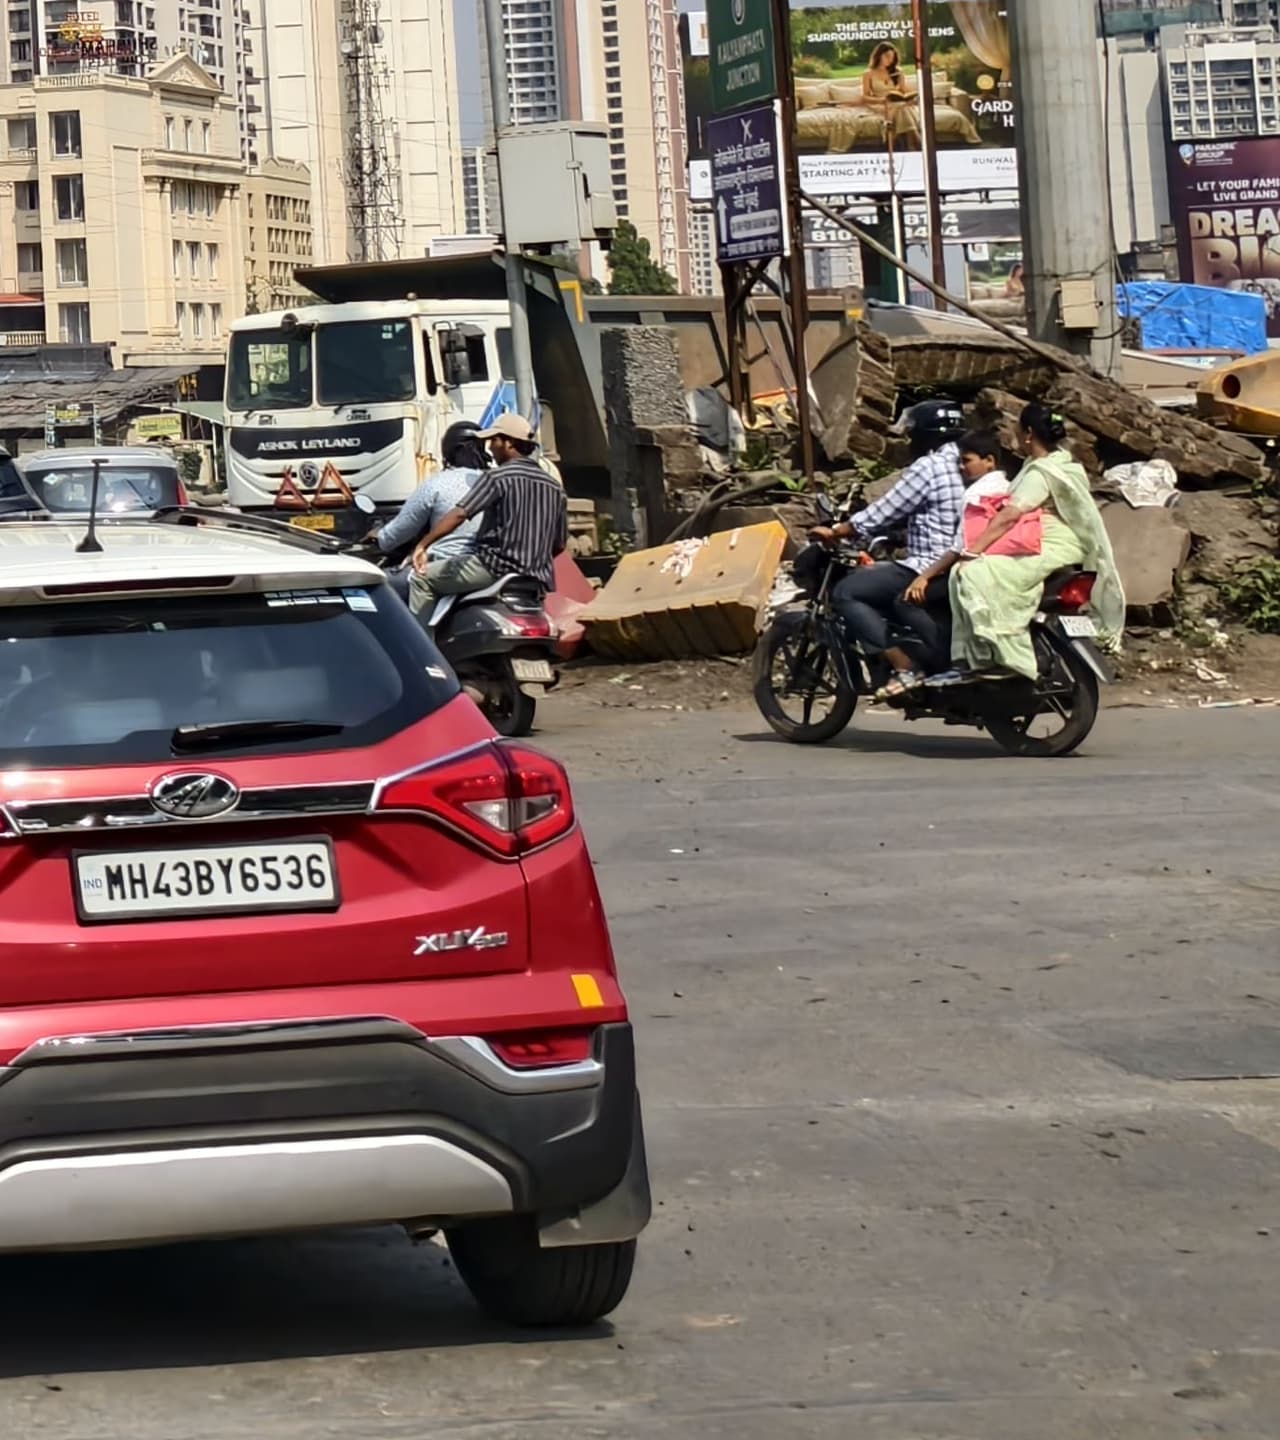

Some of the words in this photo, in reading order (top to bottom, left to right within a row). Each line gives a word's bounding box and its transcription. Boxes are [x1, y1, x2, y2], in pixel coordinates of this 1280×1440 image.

[835, 22, 859, 33] THE
[860, 20, 900, 31] READY
[807, 30, 889, 43] SURROUNDED
[890, 29, 906, 39] BY
[801, 168, 855, 179] STARTING
[1197, 181, 1216, 191] LET
[1218, 179, 1250, 191] YOUR
[1213, 192, 1238, 203] LIVE
[1239, 190, 1279, 200] GRAND
[257, 440, 298, 452] ASHOK
[301, 437, 362, 450] LEYLAND
[83, 878, 103, 889] IND
[104, 853, 327, 901] MH43BY6536
